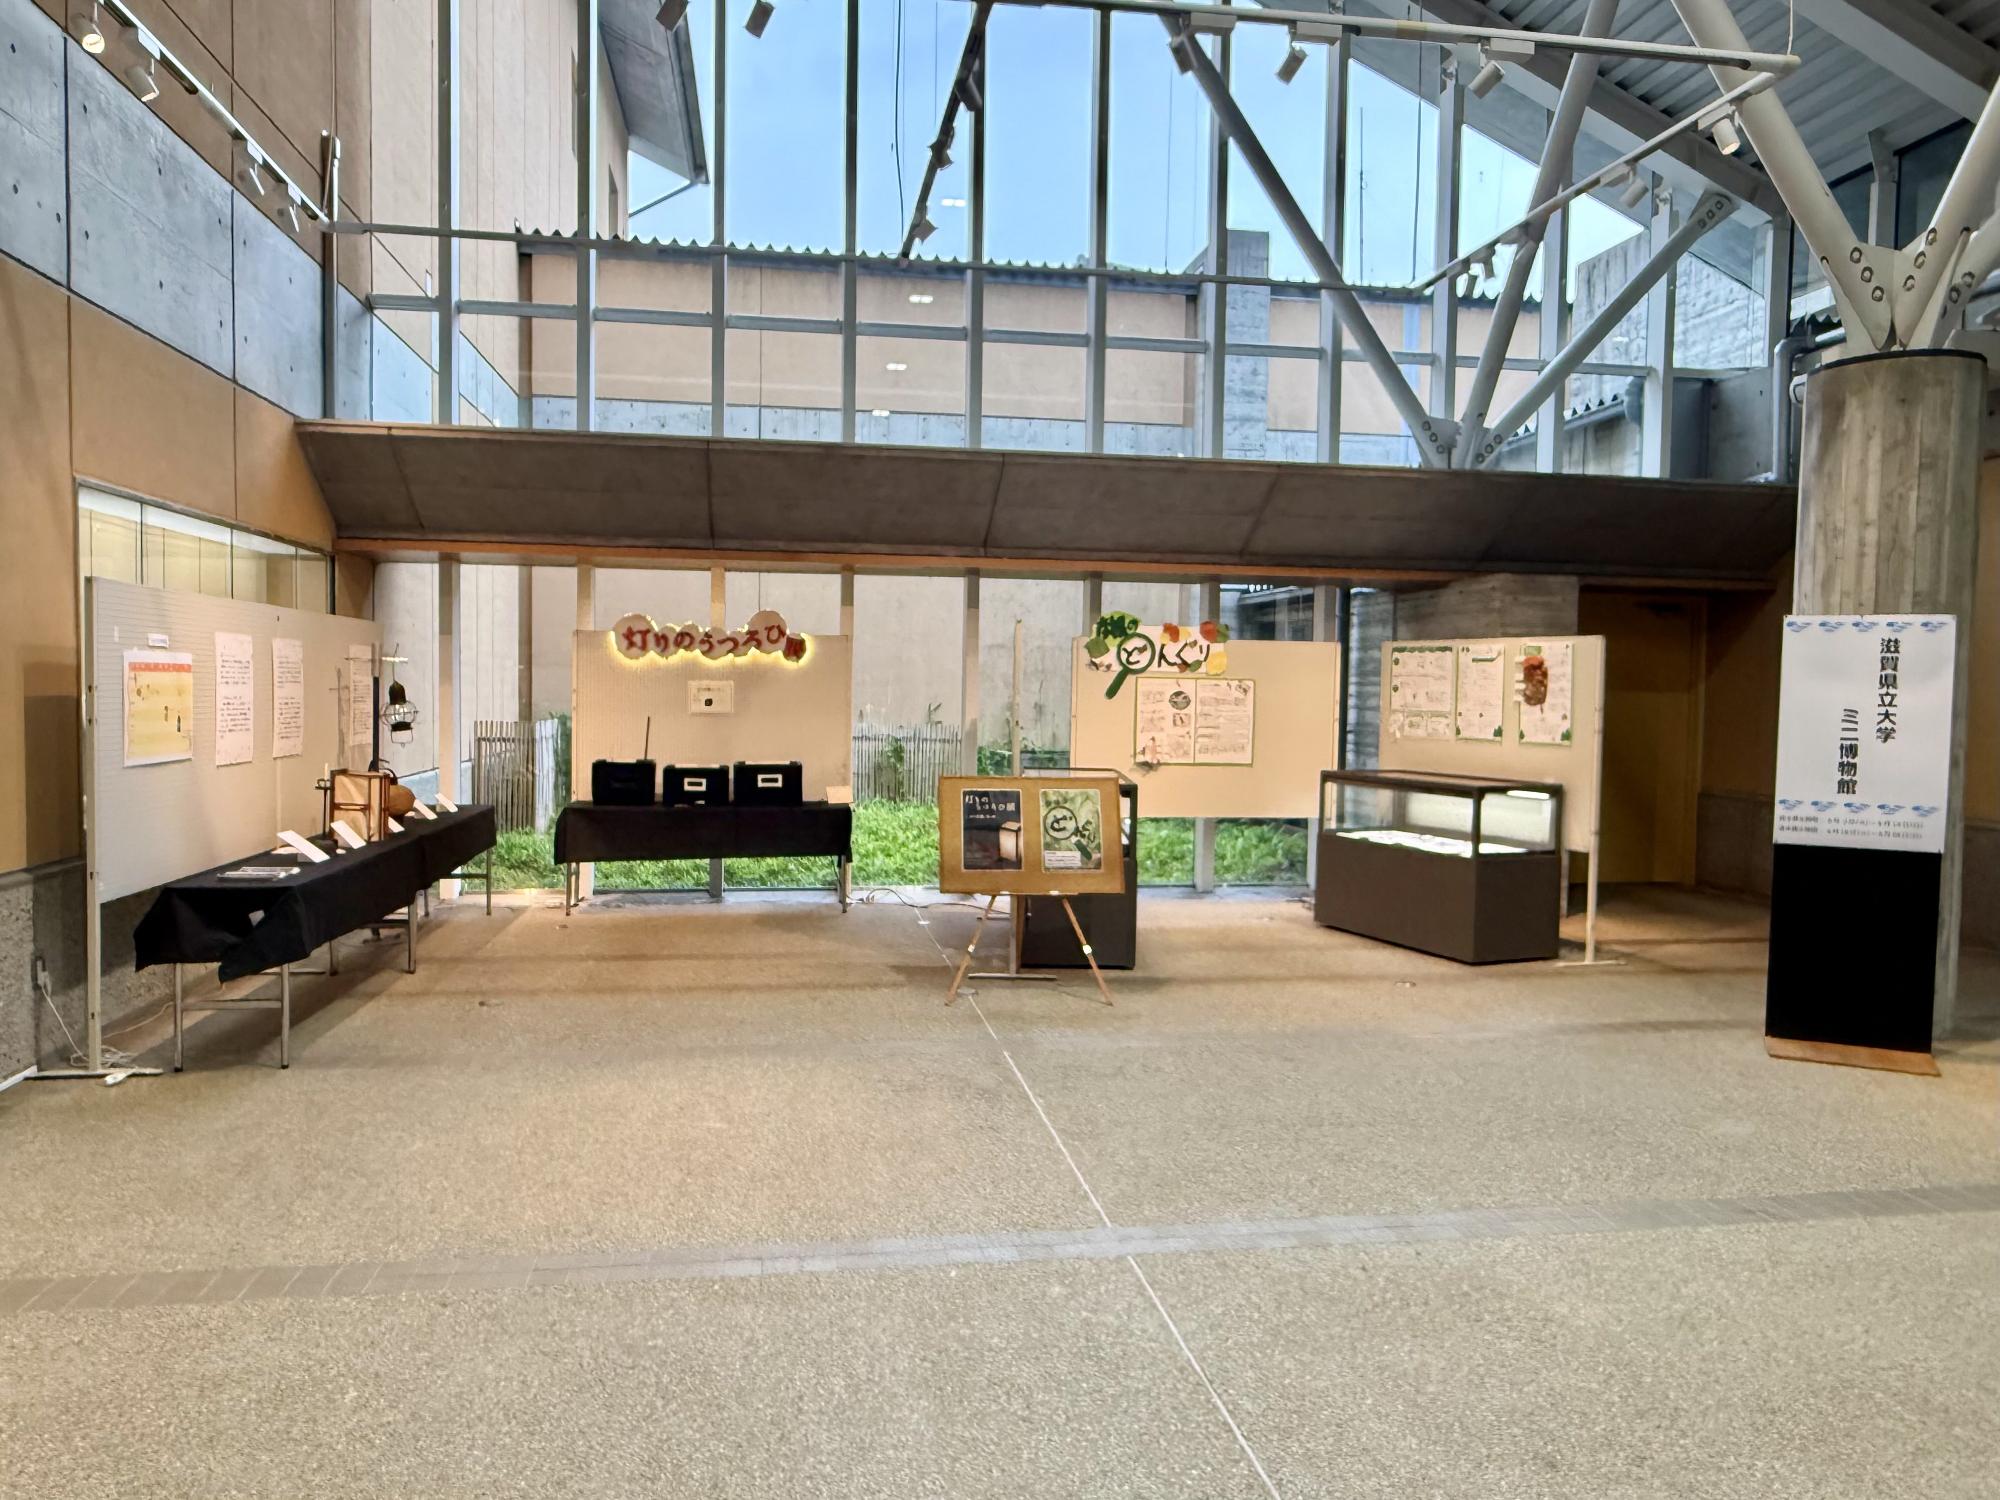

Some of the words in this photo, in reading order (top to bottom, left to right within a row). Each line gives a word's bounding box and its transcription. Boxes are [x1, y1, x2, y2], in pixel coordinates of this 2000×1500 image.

[1876, 637, 1901, 743] 滋賀県立大学
[1837, 708, 1860, 795] ミニ博物館
